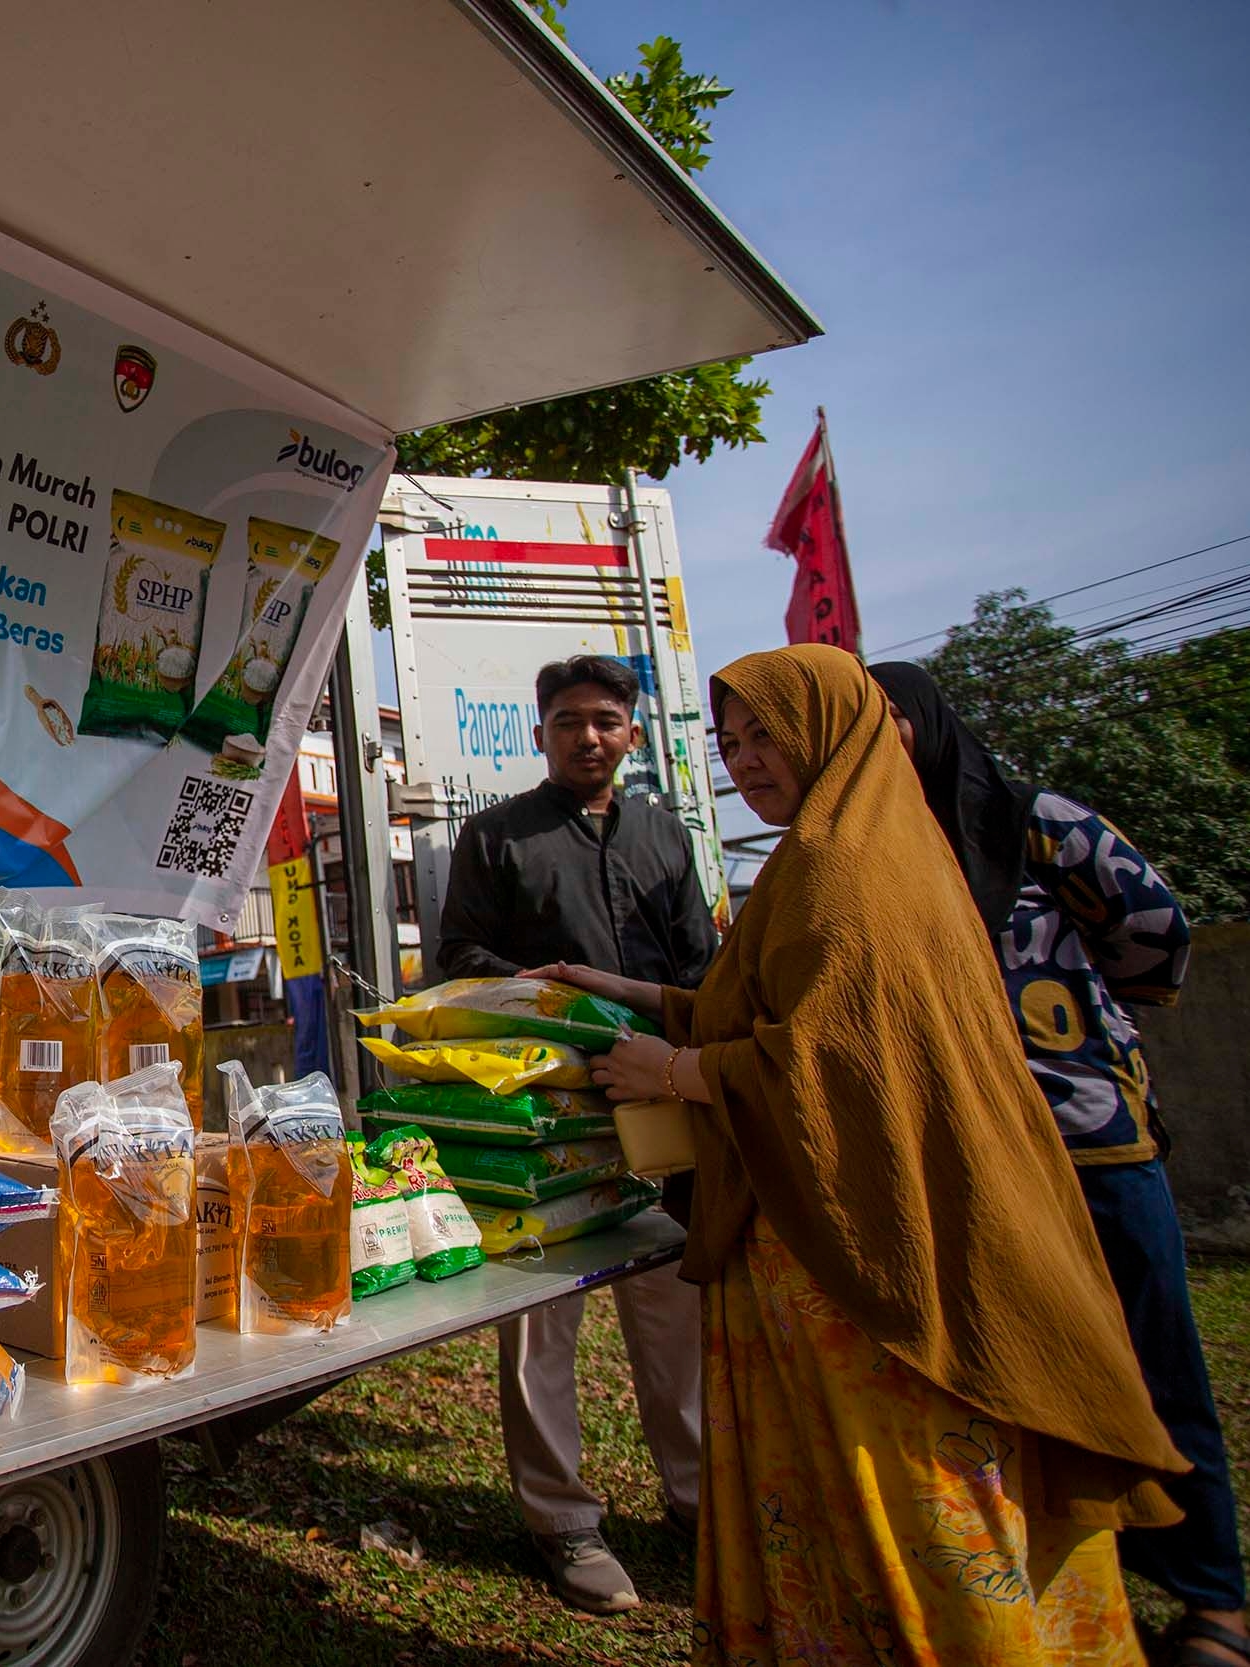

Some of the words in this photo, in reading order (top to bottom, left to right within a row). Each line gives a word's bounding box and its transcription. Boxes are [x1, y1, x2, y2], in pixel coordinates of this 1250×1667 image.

[8, 452, 96, 509] Murah
[298, 435, 364, 492] bulog
[8, 502, 90, 554] POLRI
[136, 579, 193, 610] SPHP
[454, 688, 525, 771] Pangan
